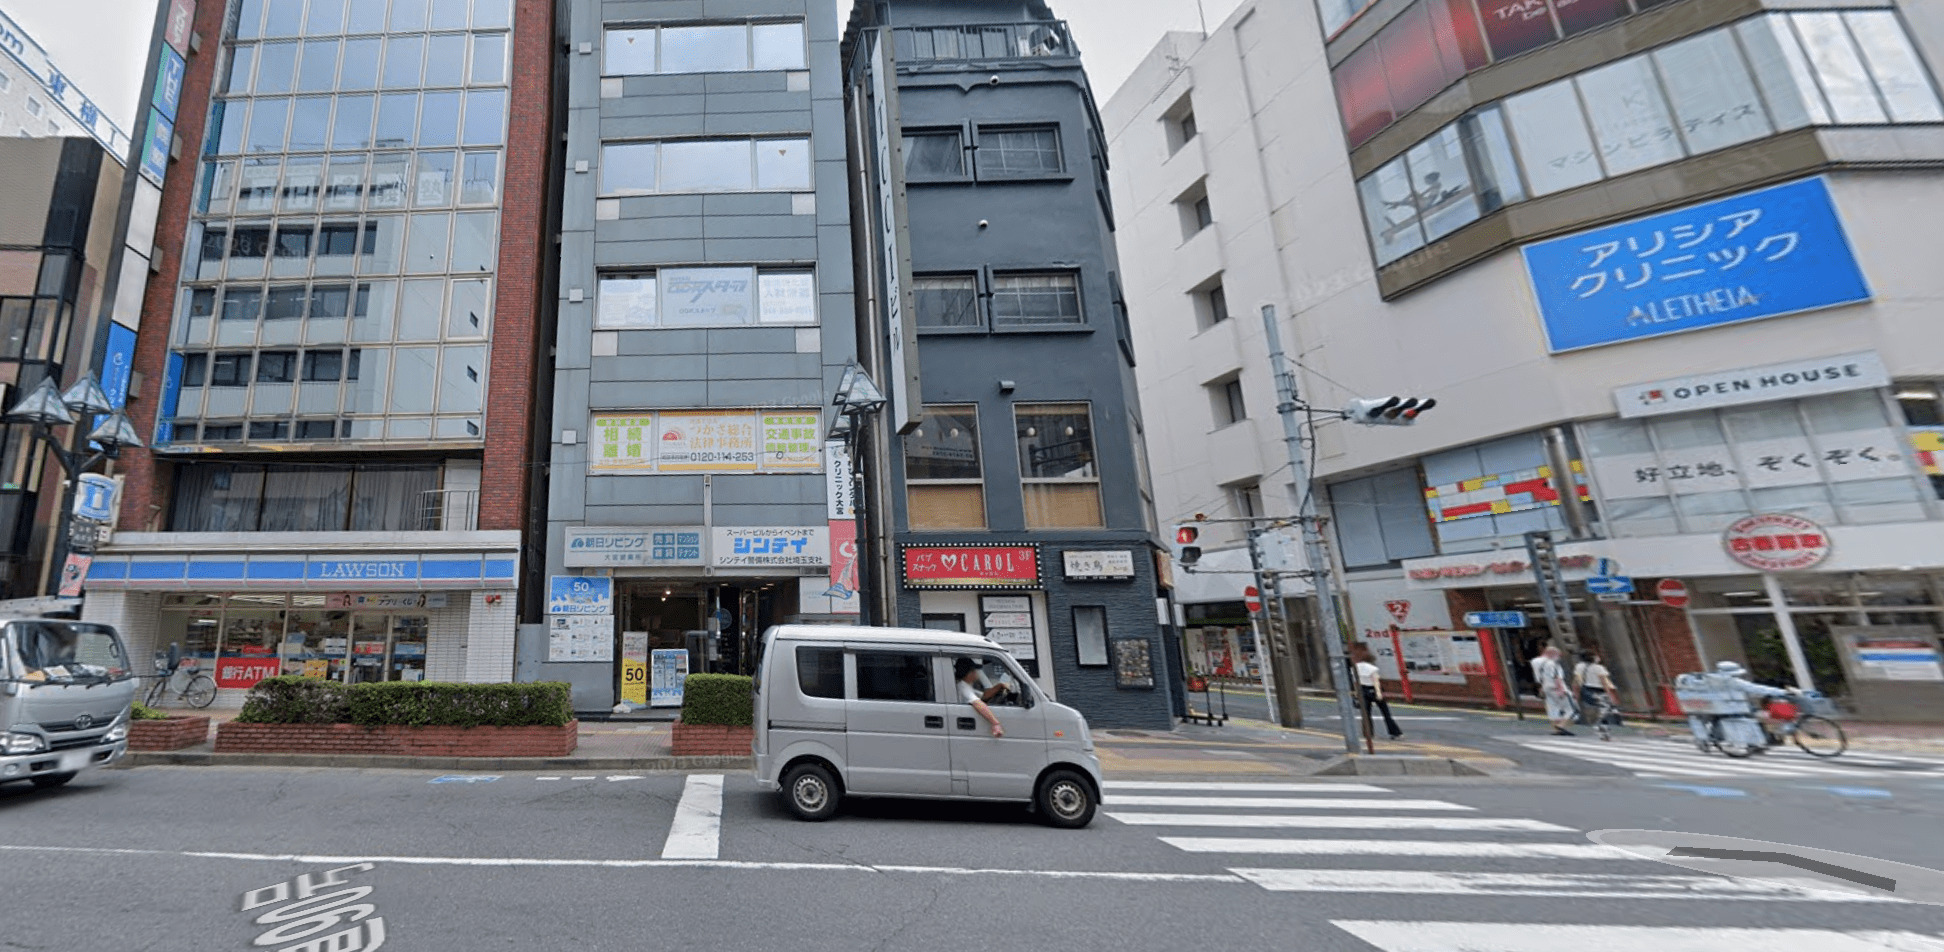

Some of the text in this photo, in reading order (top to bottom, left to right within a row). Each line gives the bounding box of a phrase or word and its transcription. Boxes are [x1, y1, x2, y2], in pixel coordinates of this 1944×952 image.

[1581, 207, 1763, 268] アリシア
[1568, 230, 1801, 298] クリニック
[1624, 285, 1761, 327] ALETHEIA
[1673, 363, 1862, 401] OPEN HOUSE
[690, 451, 754, 462] 0120-114-253
[834, 460, 844, 515] クリニック大宮
[585, 536, 645, 549] 朝日リビング
[734, 538, 807, 554] シンテイ
[719, 555, 823, 565] シンテイ警備株式会社埼玉支社
[960, 553, 1015, 572] CAROL
[320, 562, 406, 579] LAWSON
[573, 581, 589, 592] 50
[221, 664, 277, 681] 銀行ATM
[625, 667, 644, 682] 50
